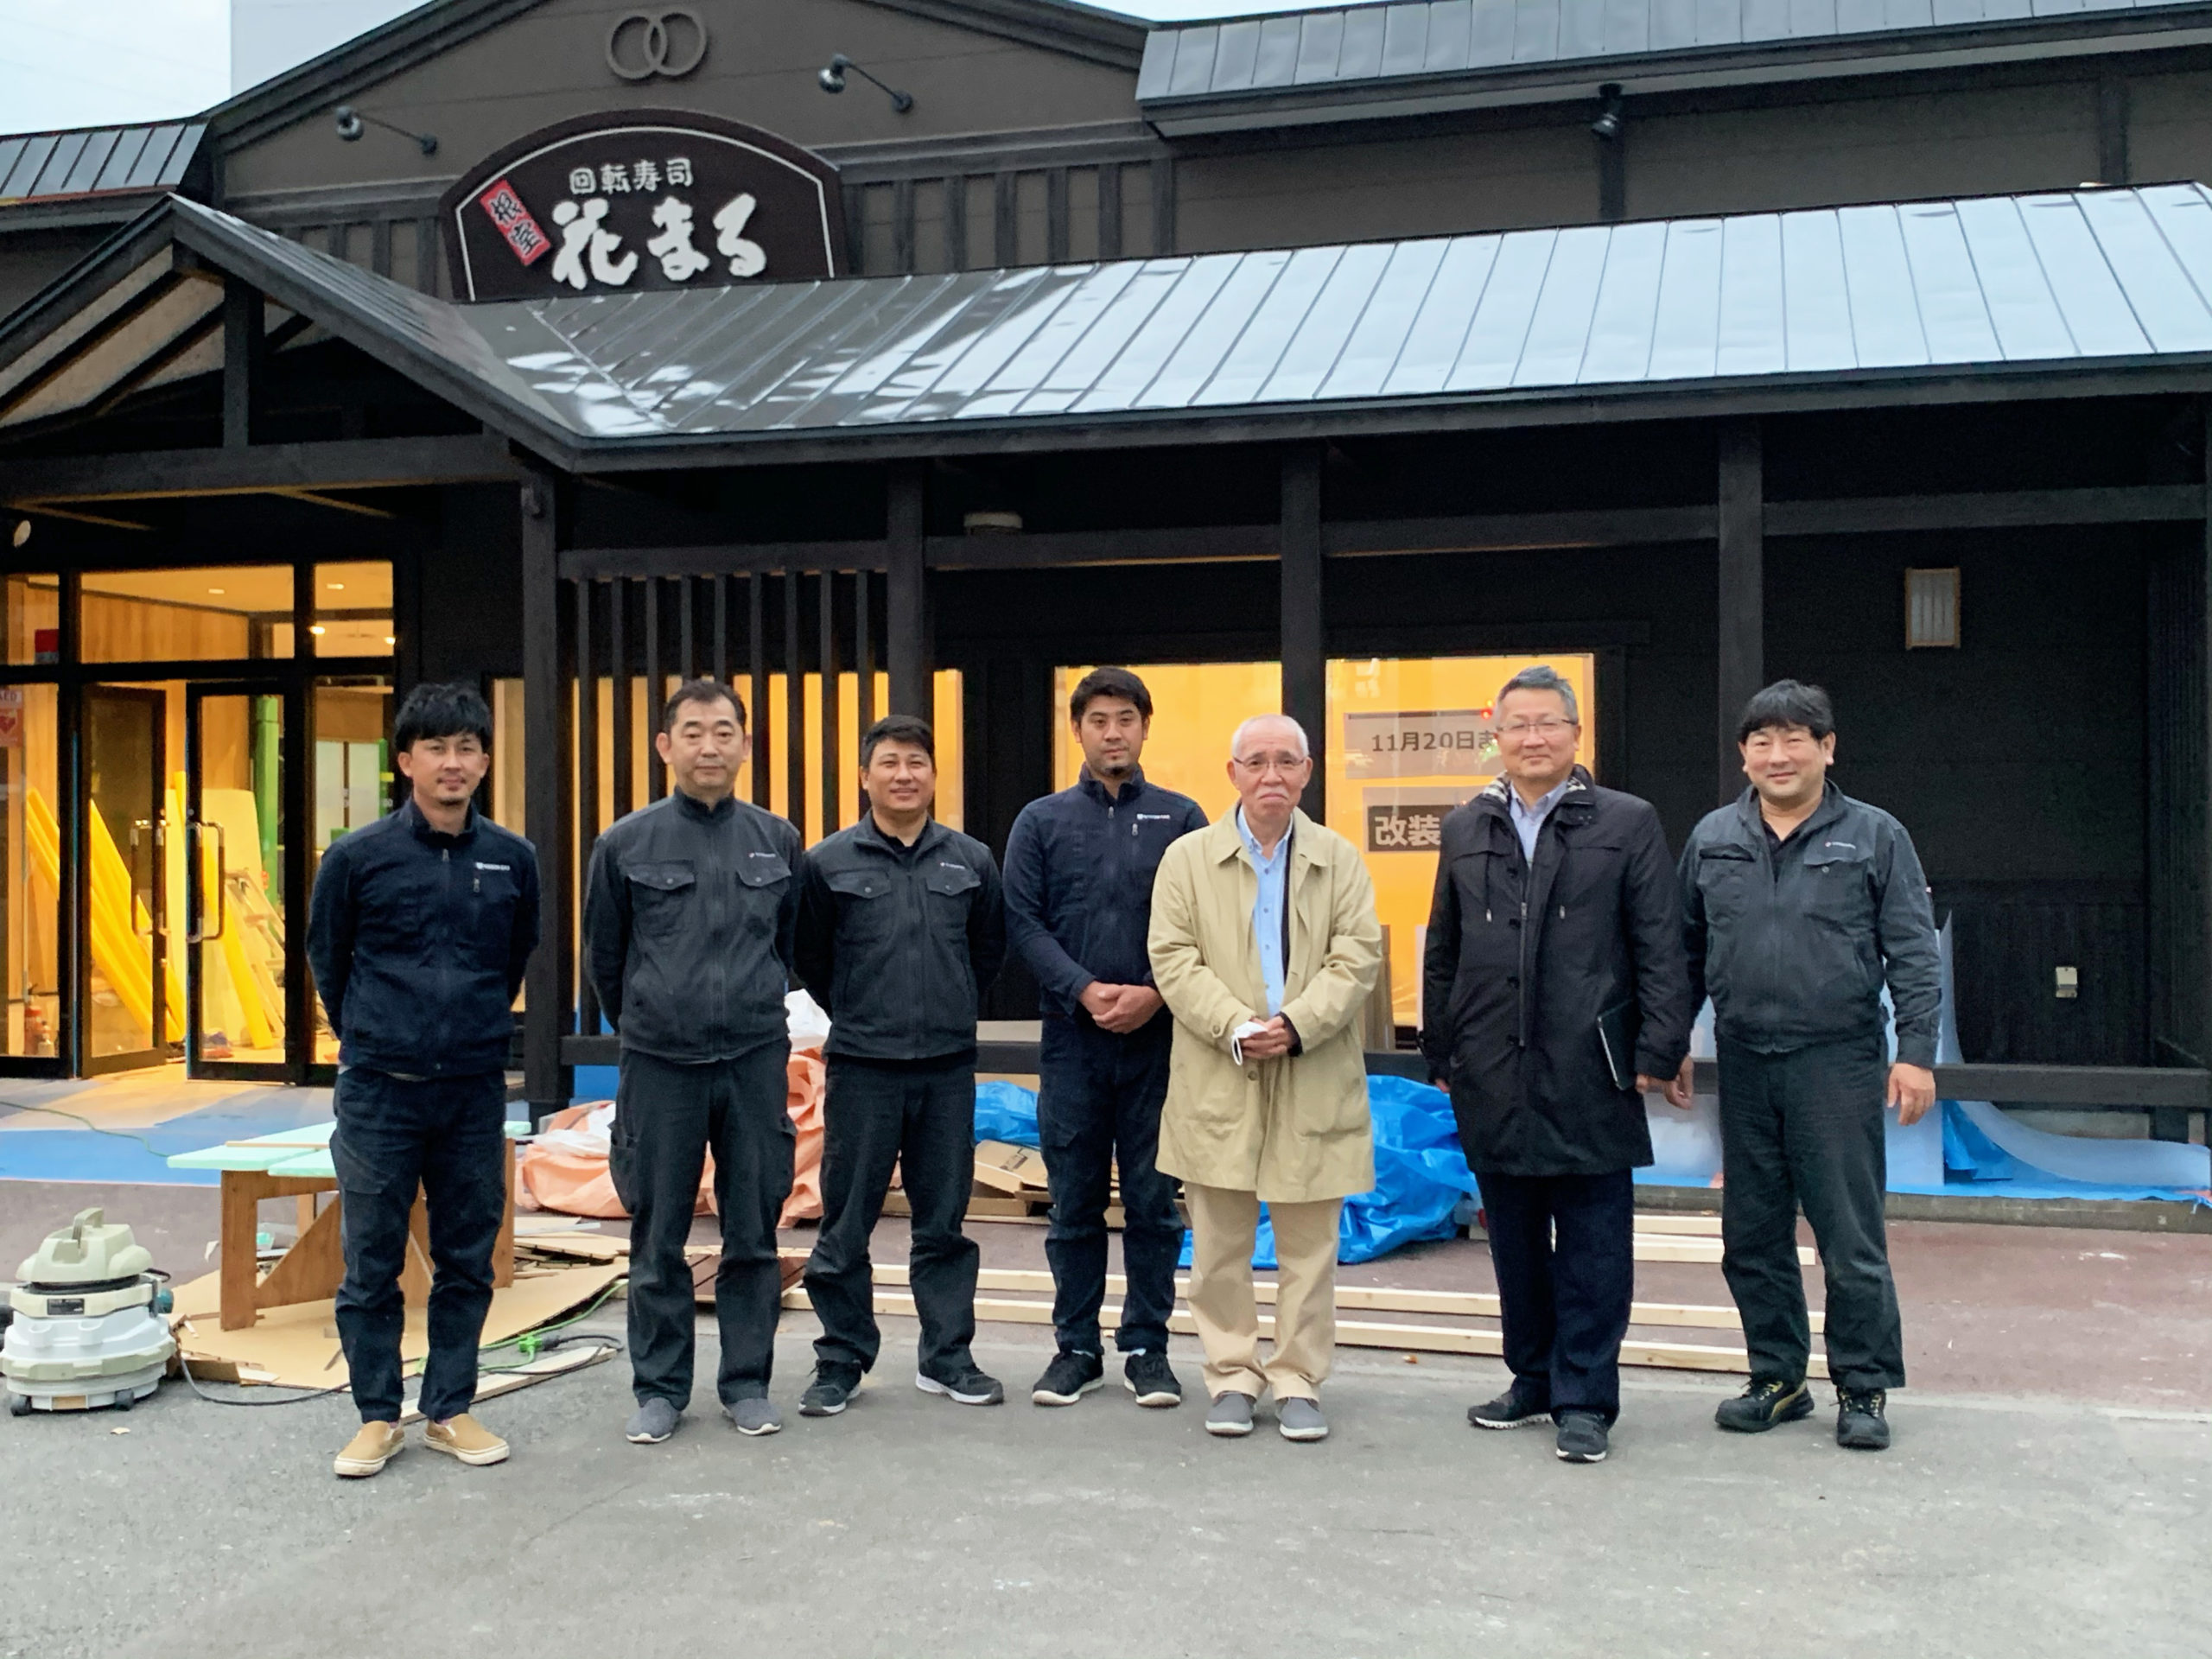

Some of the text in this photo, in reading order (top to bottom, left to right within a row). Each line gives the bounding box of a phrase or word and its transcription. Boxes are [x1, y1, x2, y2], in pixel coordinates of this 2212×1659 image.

[569, 157, 694, 195] 回転寿司
[551, 193, 767, 290] 花まる
[1374, 814, 1441, 847] 改装
